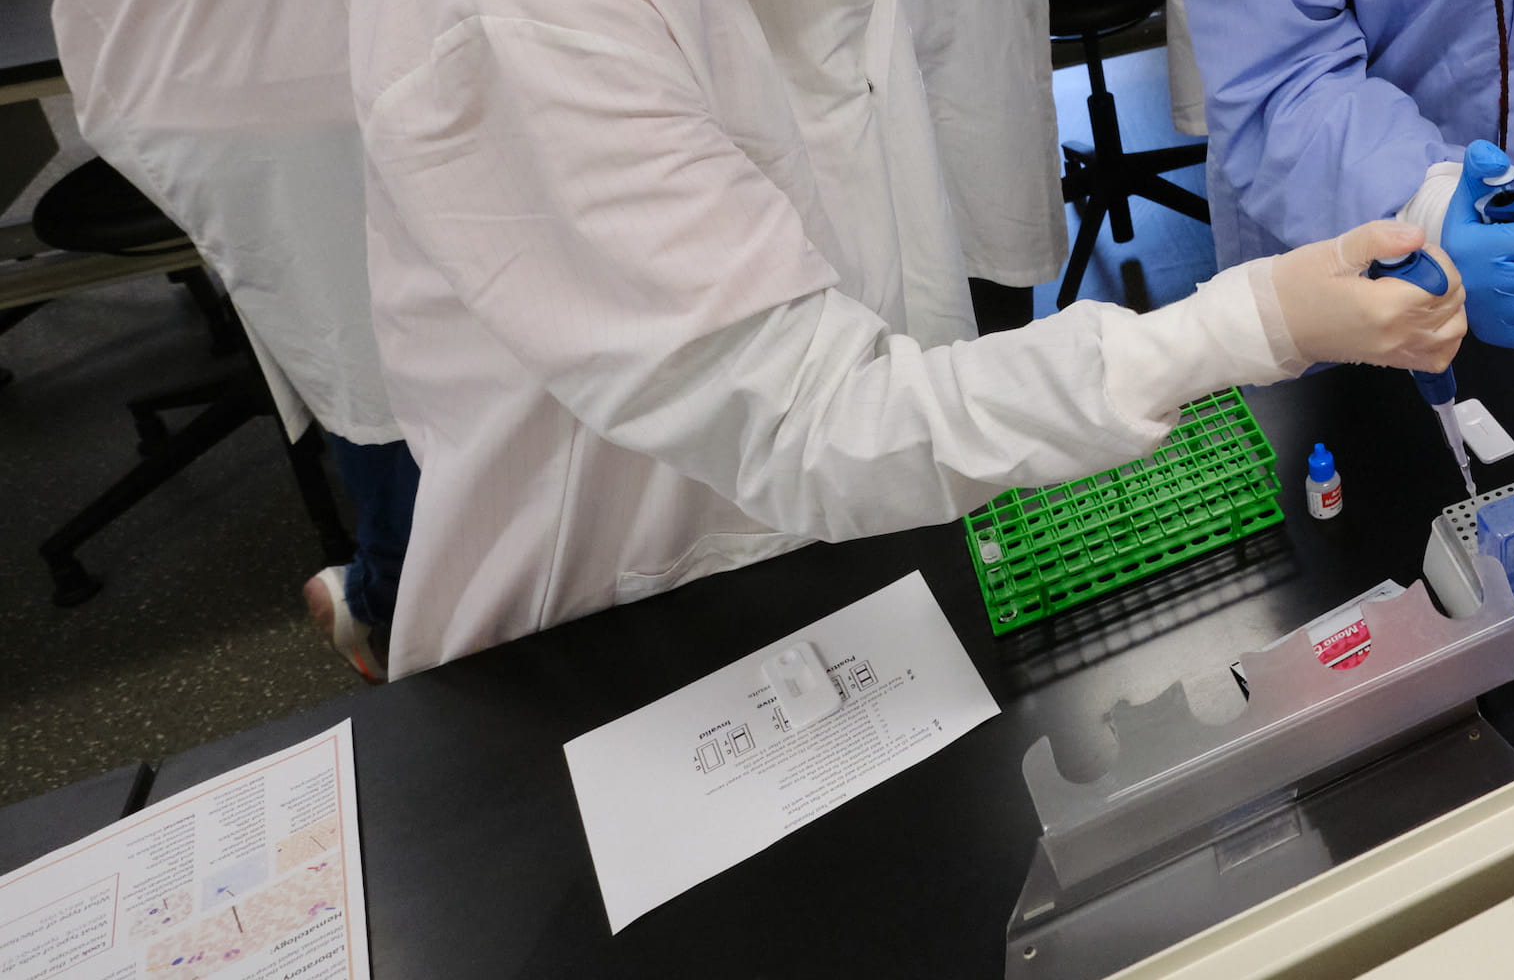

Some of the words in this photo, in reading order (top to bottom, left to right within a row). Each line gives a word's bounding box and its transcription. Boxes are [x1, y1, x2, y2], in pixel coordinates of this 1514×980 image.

[1323, 624, 1359, 649] Mono
[825, 654, 855, 675] Positiv
[698, 719, 731, 740] Invalid
